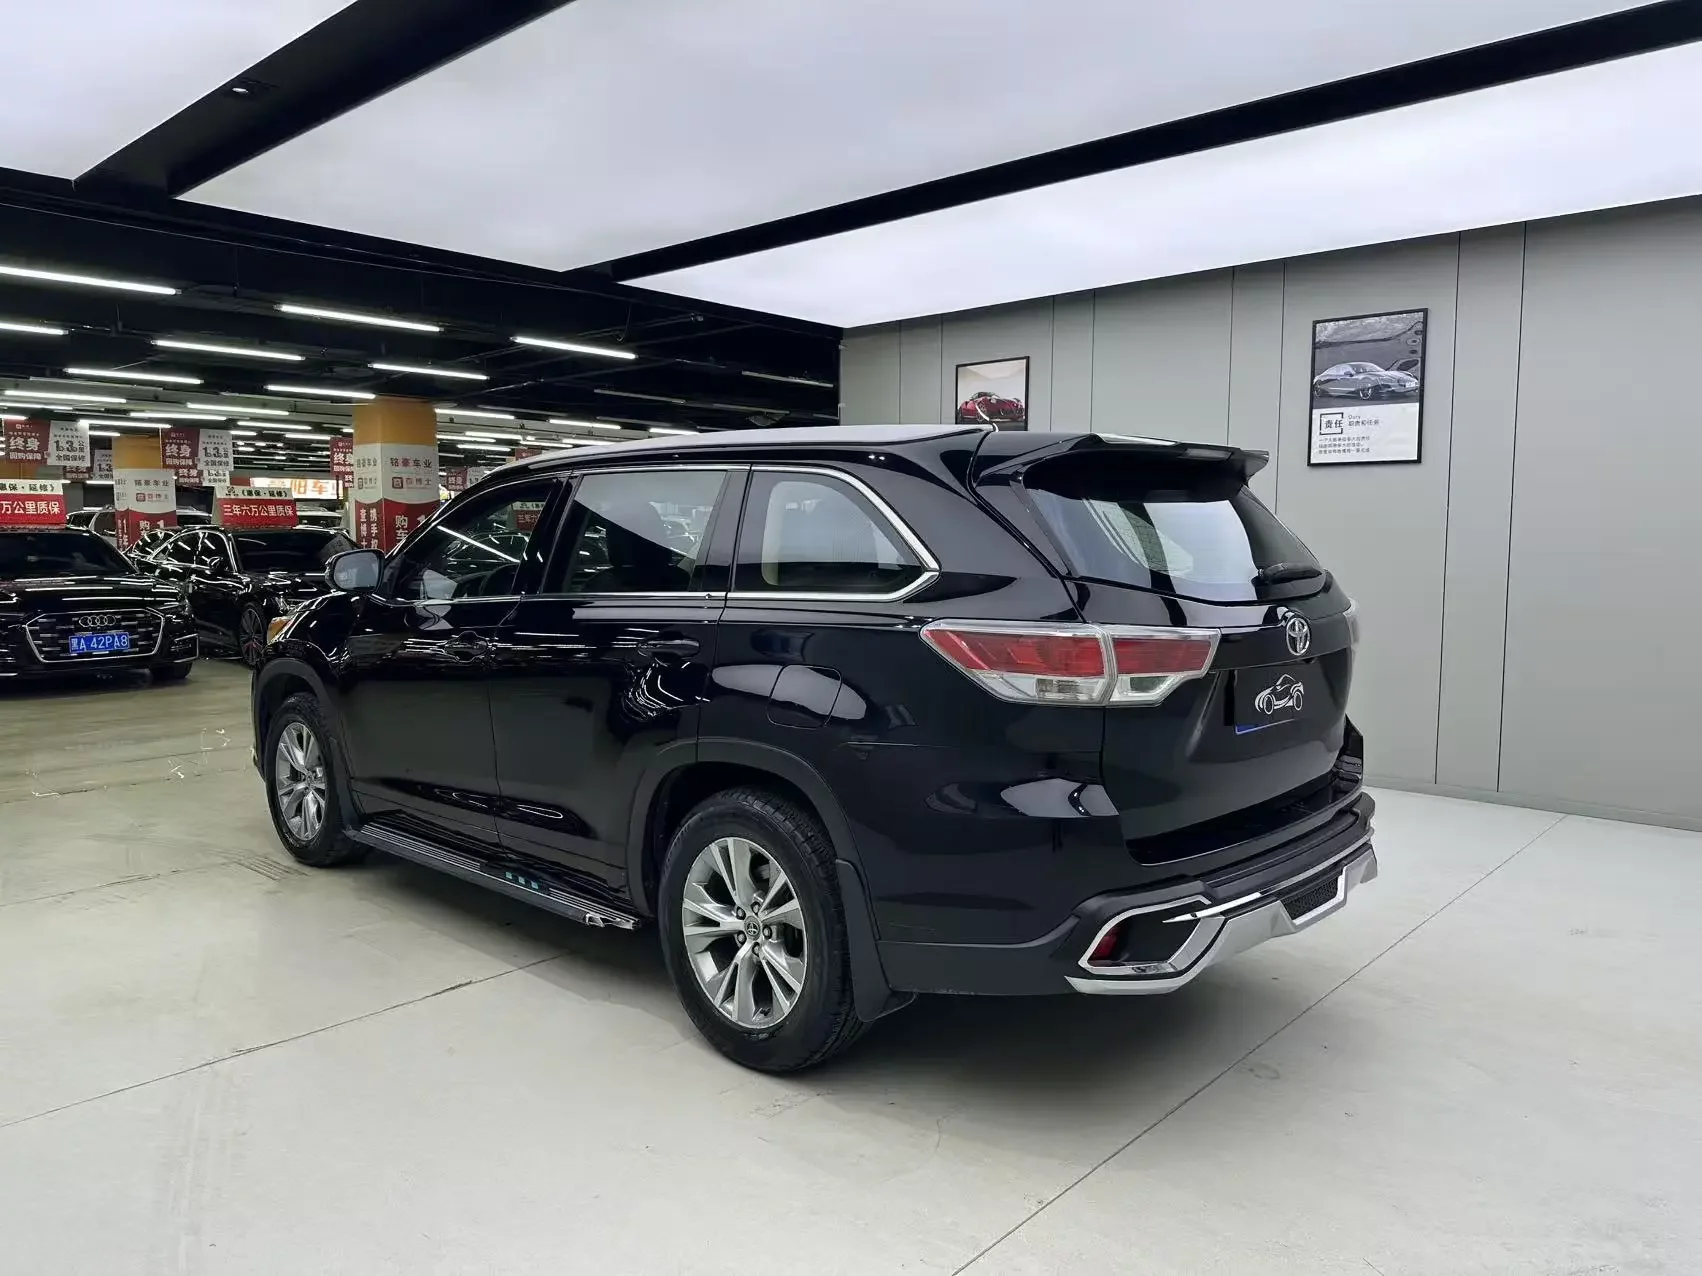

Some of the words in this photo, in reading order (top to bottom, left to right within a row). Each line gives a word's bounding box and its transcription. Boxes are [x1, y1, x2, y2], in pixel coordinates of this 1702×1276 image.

[1325, 419, 1343, 428] 责任
[9, 436, 40, 451] 终身
[166, 444, 191, 457] 终身
[55, 454, 86, 462] 全国保修
[0, 501, 60, 514] 万公里质保
[223, 504, 295, 516] 三年六万公里质保
